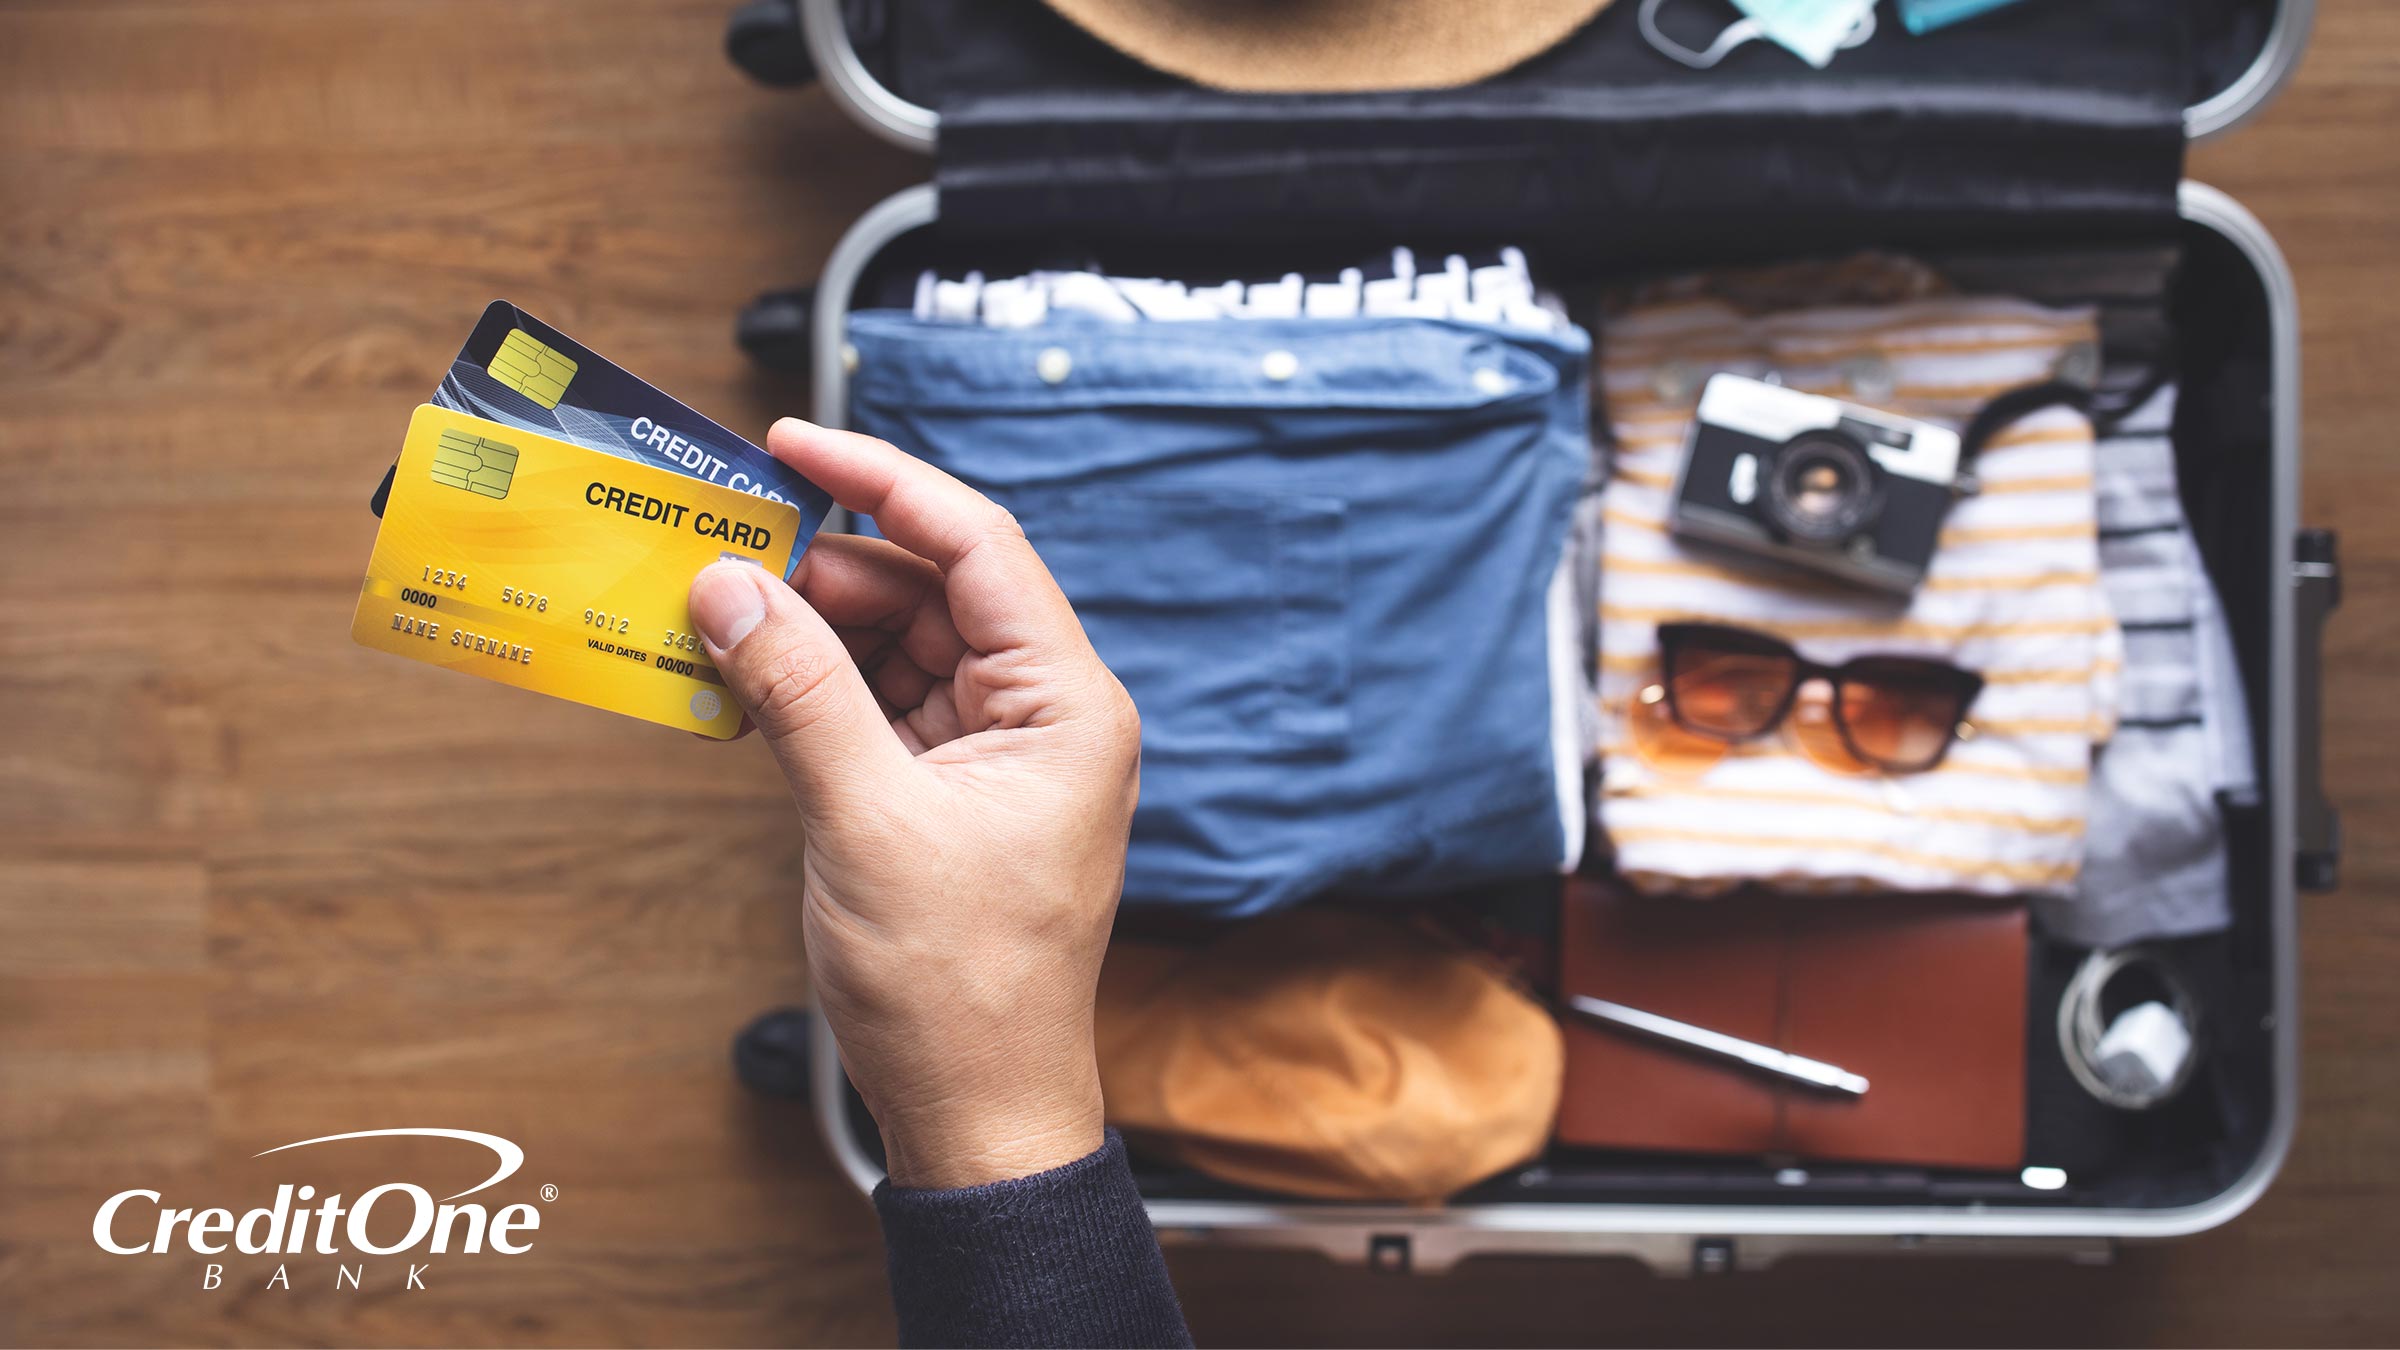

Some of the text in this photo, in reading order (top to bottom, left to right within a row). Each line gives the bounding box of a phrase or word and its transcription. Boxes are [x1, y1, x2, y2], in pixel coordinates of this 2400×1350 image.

[631, 416, 728, 482] CREDIT
[585, 482, 771, 551] CREDIT CARD
[401, 588, 437, 609] 0000
[422, 565, 468, 591] 1234
[502, 586, 549, 612] 5678
[584, 608, 630, 635] 9012
[392, 613, 533, 664] NAME SURNAME
[588, 639, 694, 677] VALID DATES 00/00
